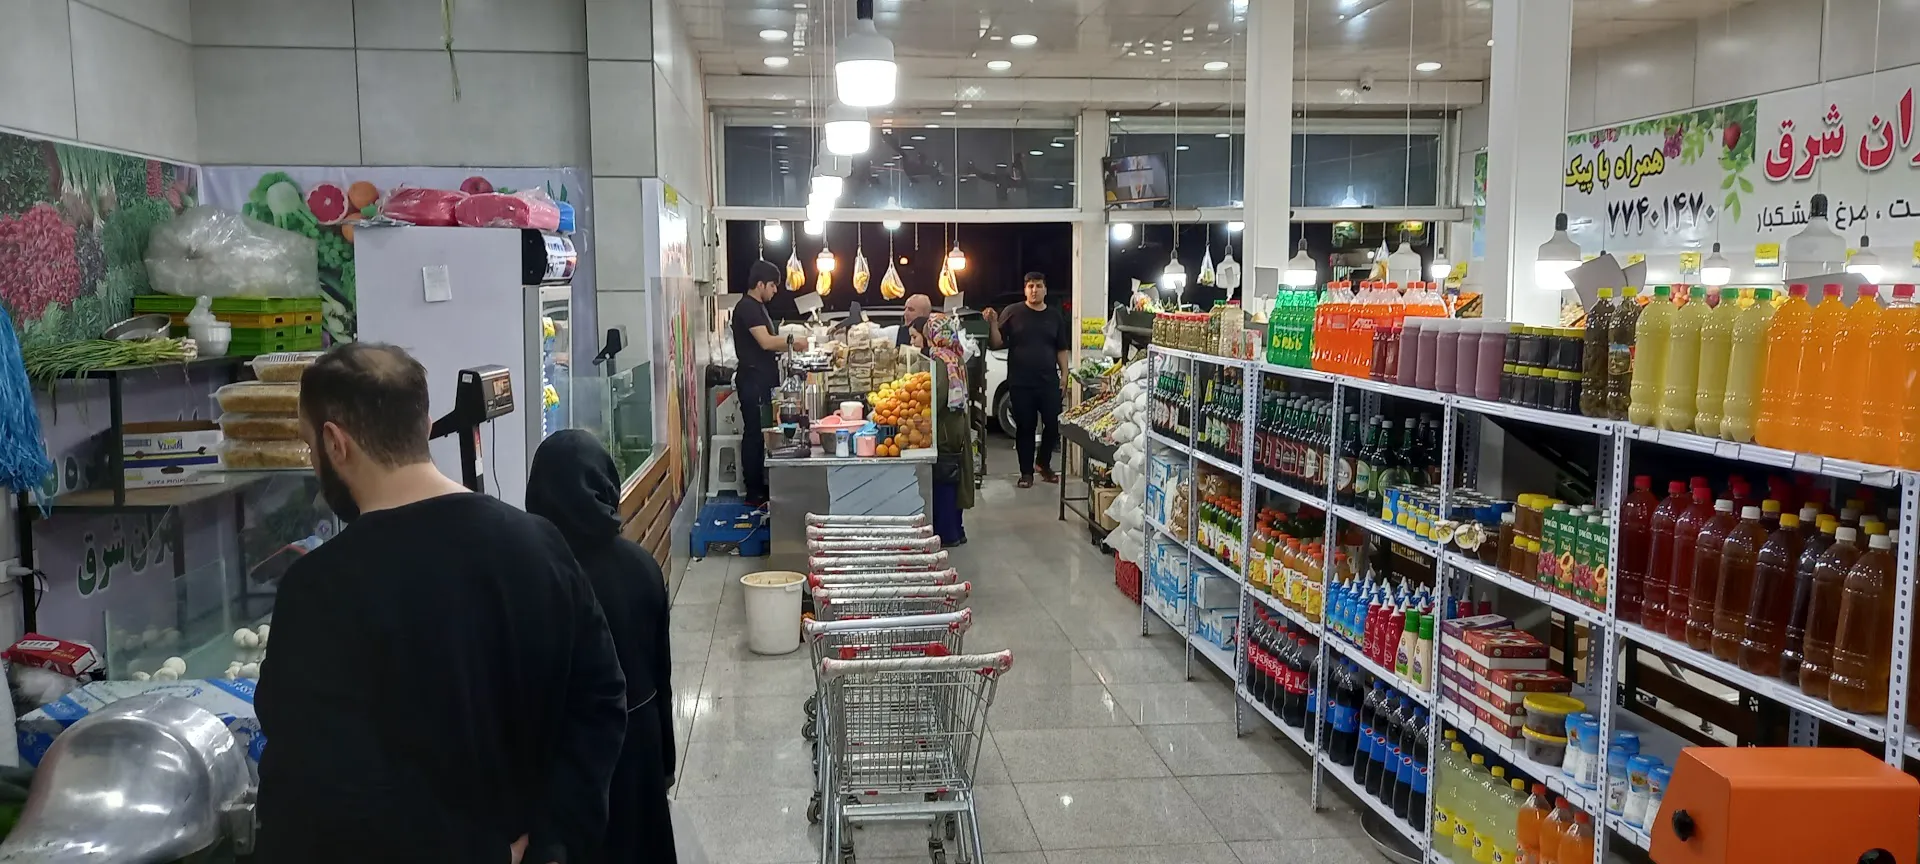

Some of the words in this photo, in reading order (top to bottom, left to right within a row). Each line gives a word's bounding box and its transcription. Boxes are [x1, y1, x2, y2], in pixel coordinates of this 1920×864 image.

[1764, 103, 1845, 179] شرق
[1597, 149, 1610, 189] با
[1614, 144, 1665, 188] همراه
[1607, 191, 1716, 235] ۷۷۴۰۱۴۷۰
[1757, 200, 1811, 233] شکبار
[1835, 200, 1869, 230] مرغ
[77, 516, 125, 597] شرق
